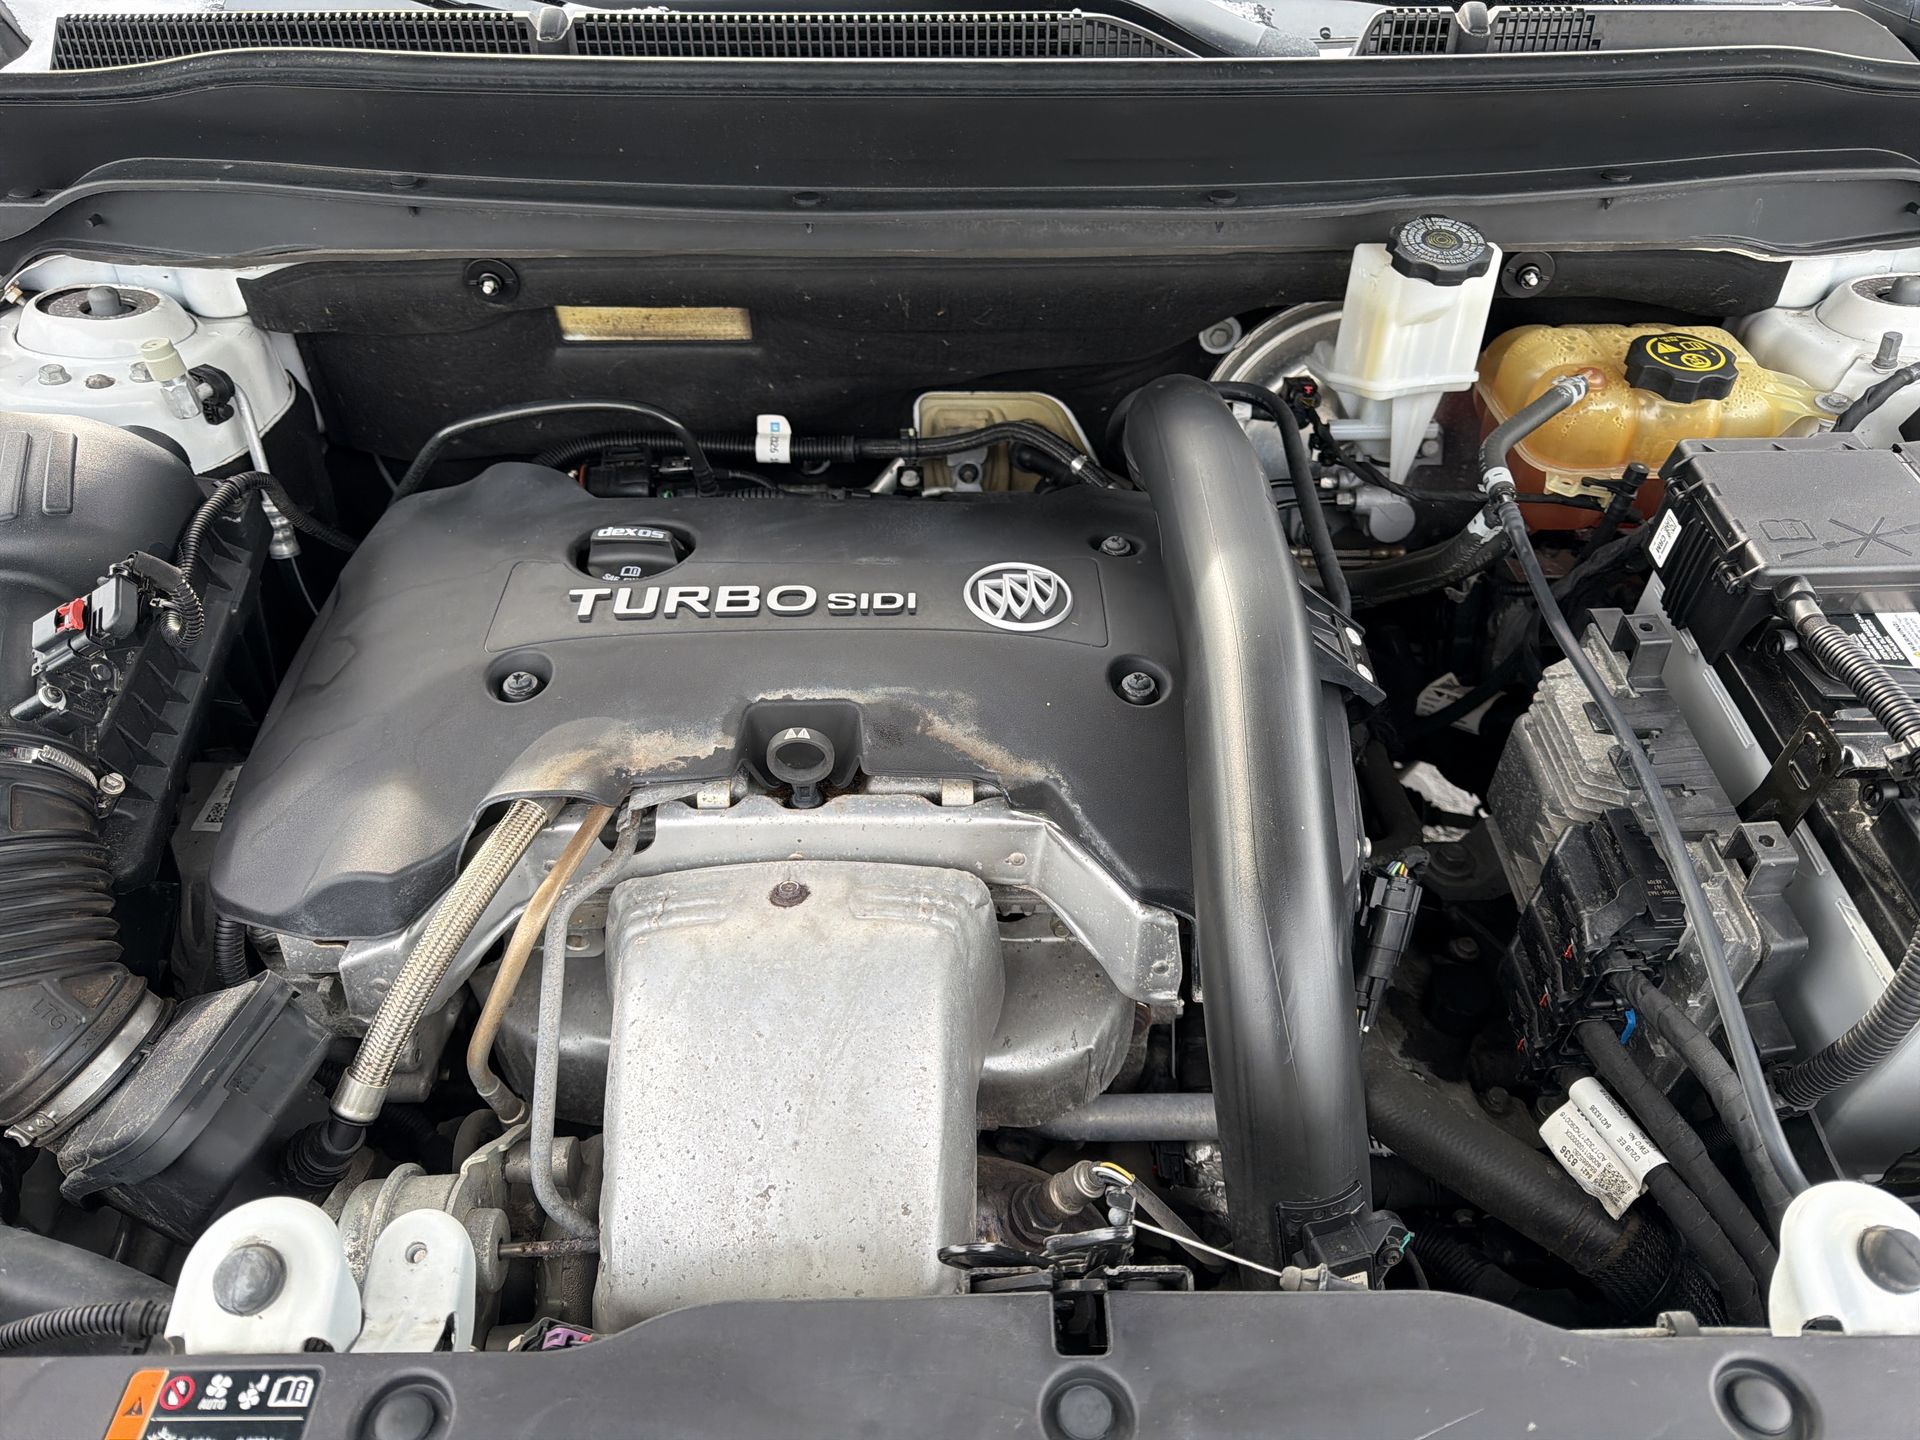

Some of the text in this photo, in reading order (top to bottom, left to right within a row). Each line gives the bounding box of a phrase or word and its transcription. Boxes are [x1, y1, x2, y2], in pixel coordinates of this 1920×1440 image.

[597, 527, 665, 539] dexos
[569, 585, 917, 620] TURBO SIDI
[32, 998, 67, 1031] LTG
[1615, 1135, 1627, 1146] EE
[1558, 1144, 1579, 1166] 8336
[197, 1397, 227, 1410] AUTO
